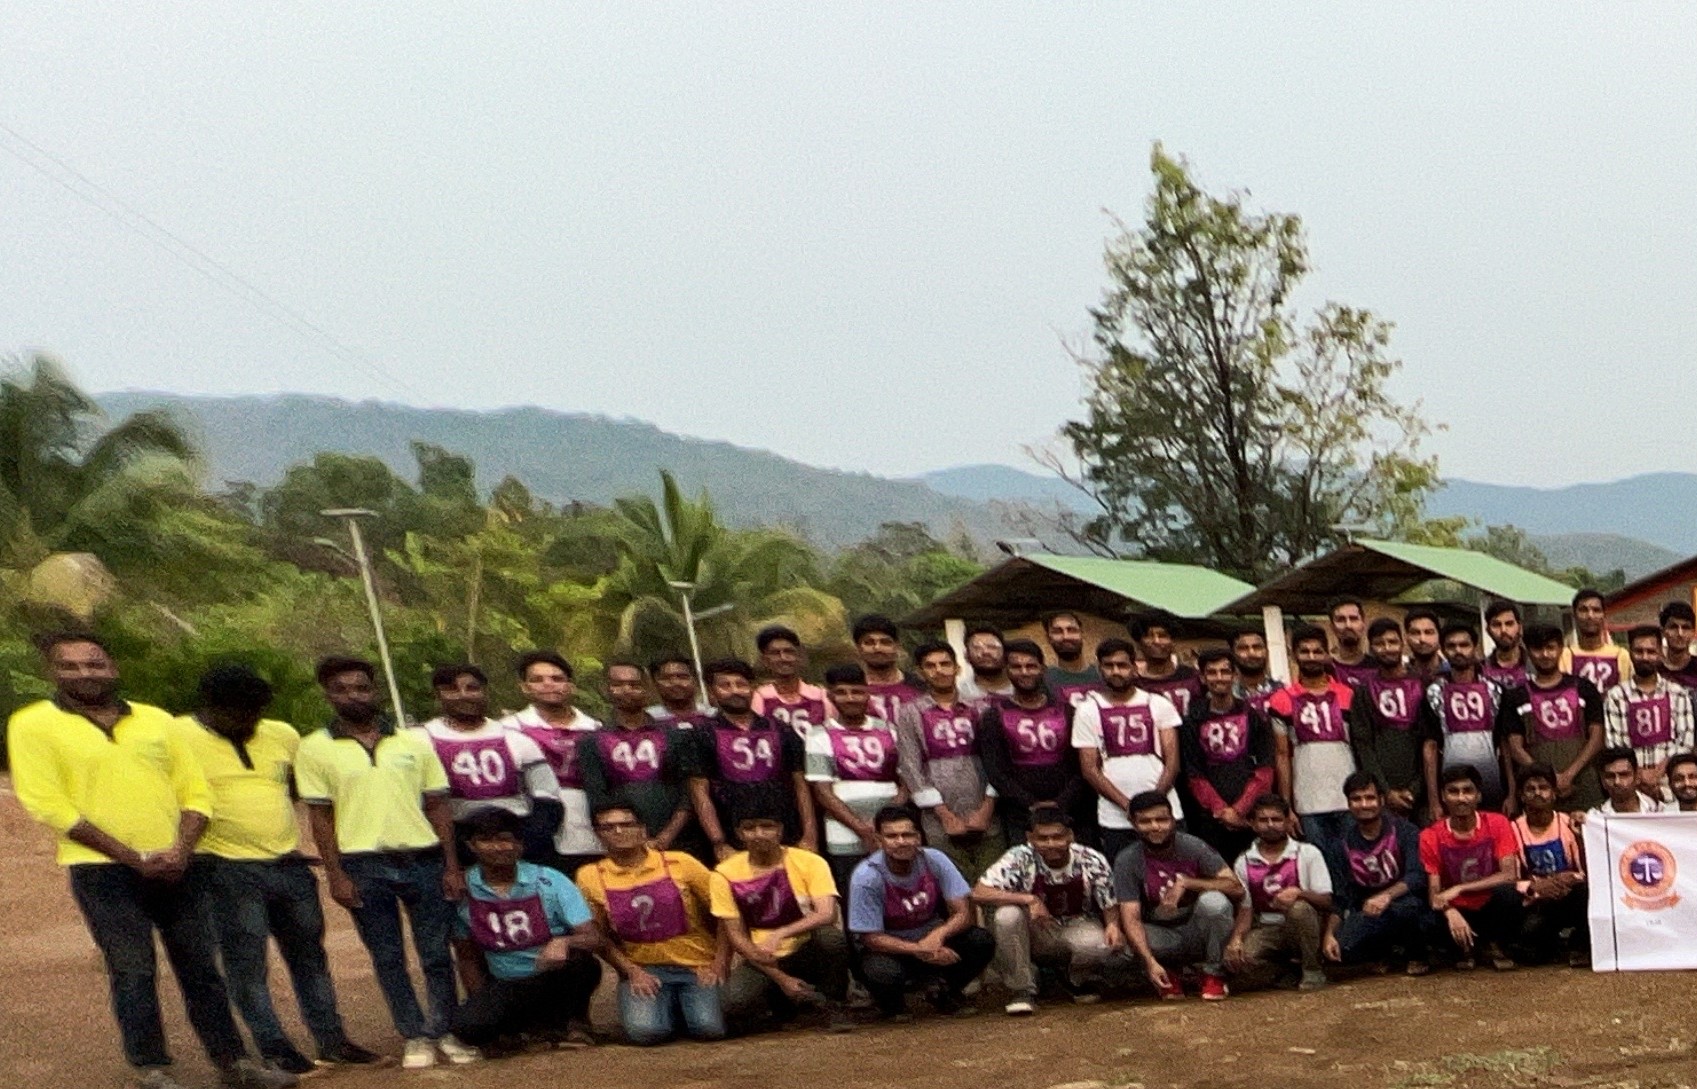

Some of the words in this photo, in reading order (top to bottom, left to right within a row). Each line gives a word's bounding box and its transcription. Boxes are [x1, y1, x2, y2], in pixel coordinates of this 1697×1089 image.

[1301, 701, 1332, 734] 41
[1379, 687, 1407, 718] 61
[1451, 691, 1485, 721] 69
[1016, 719, 1057, 751] 56
[1109, 715, 1148, 747] 75
[1635, 707, 1661, 737] 81
[453, 750, 505, 785] 40
[612, 740, 660, 770] 44
[732, 738, 773, 771] 54
[841, 736, 885, 772] 39
